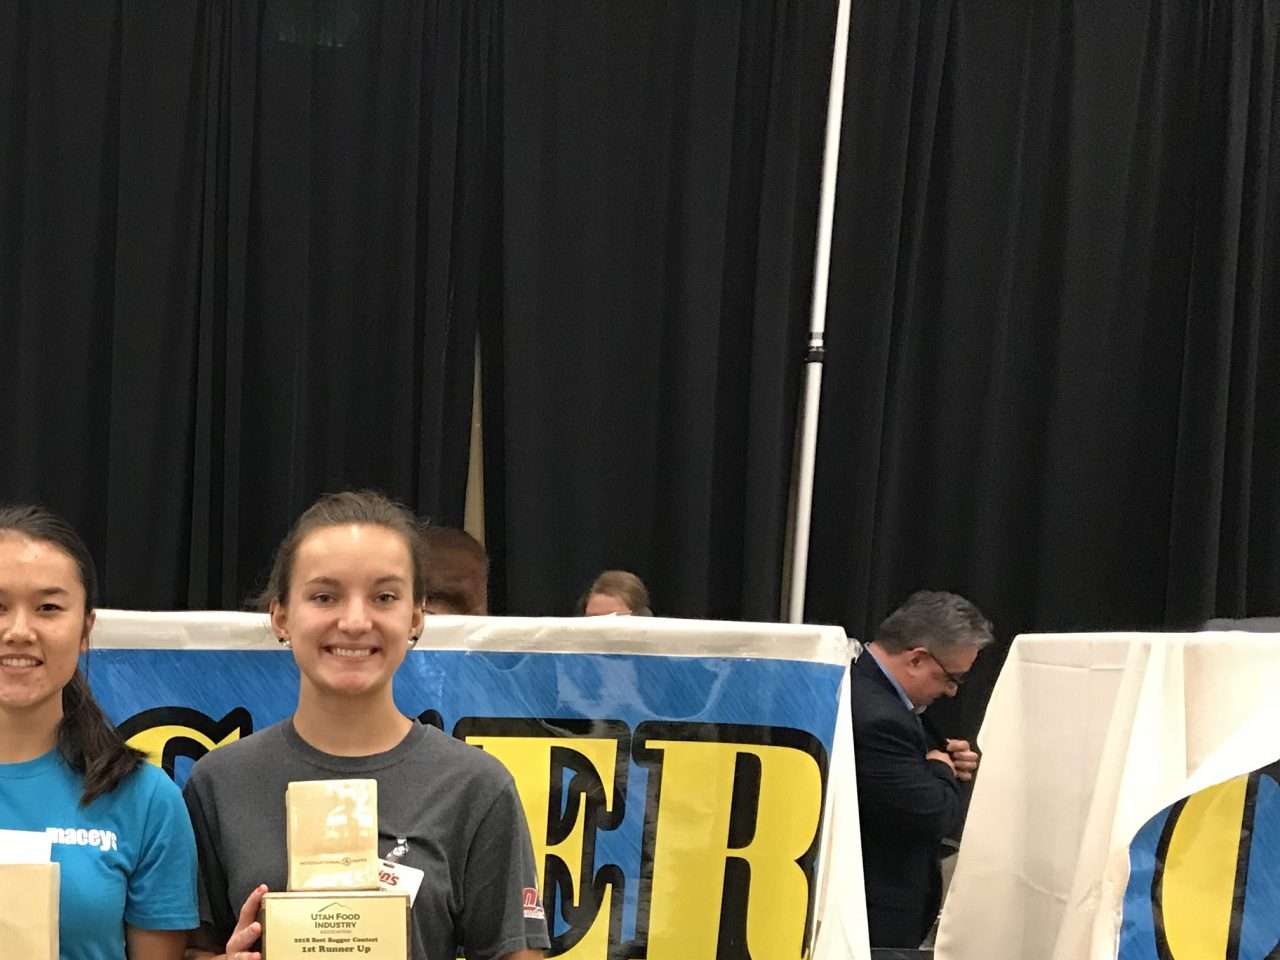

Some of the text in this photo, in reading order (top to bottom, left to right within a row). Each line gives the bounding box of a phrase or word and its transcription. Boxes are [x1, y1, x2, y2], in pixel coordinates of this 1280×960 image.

[311, 913, 334, 921] UTAH
[302, 945, 371, 954] 1st Runner Up
